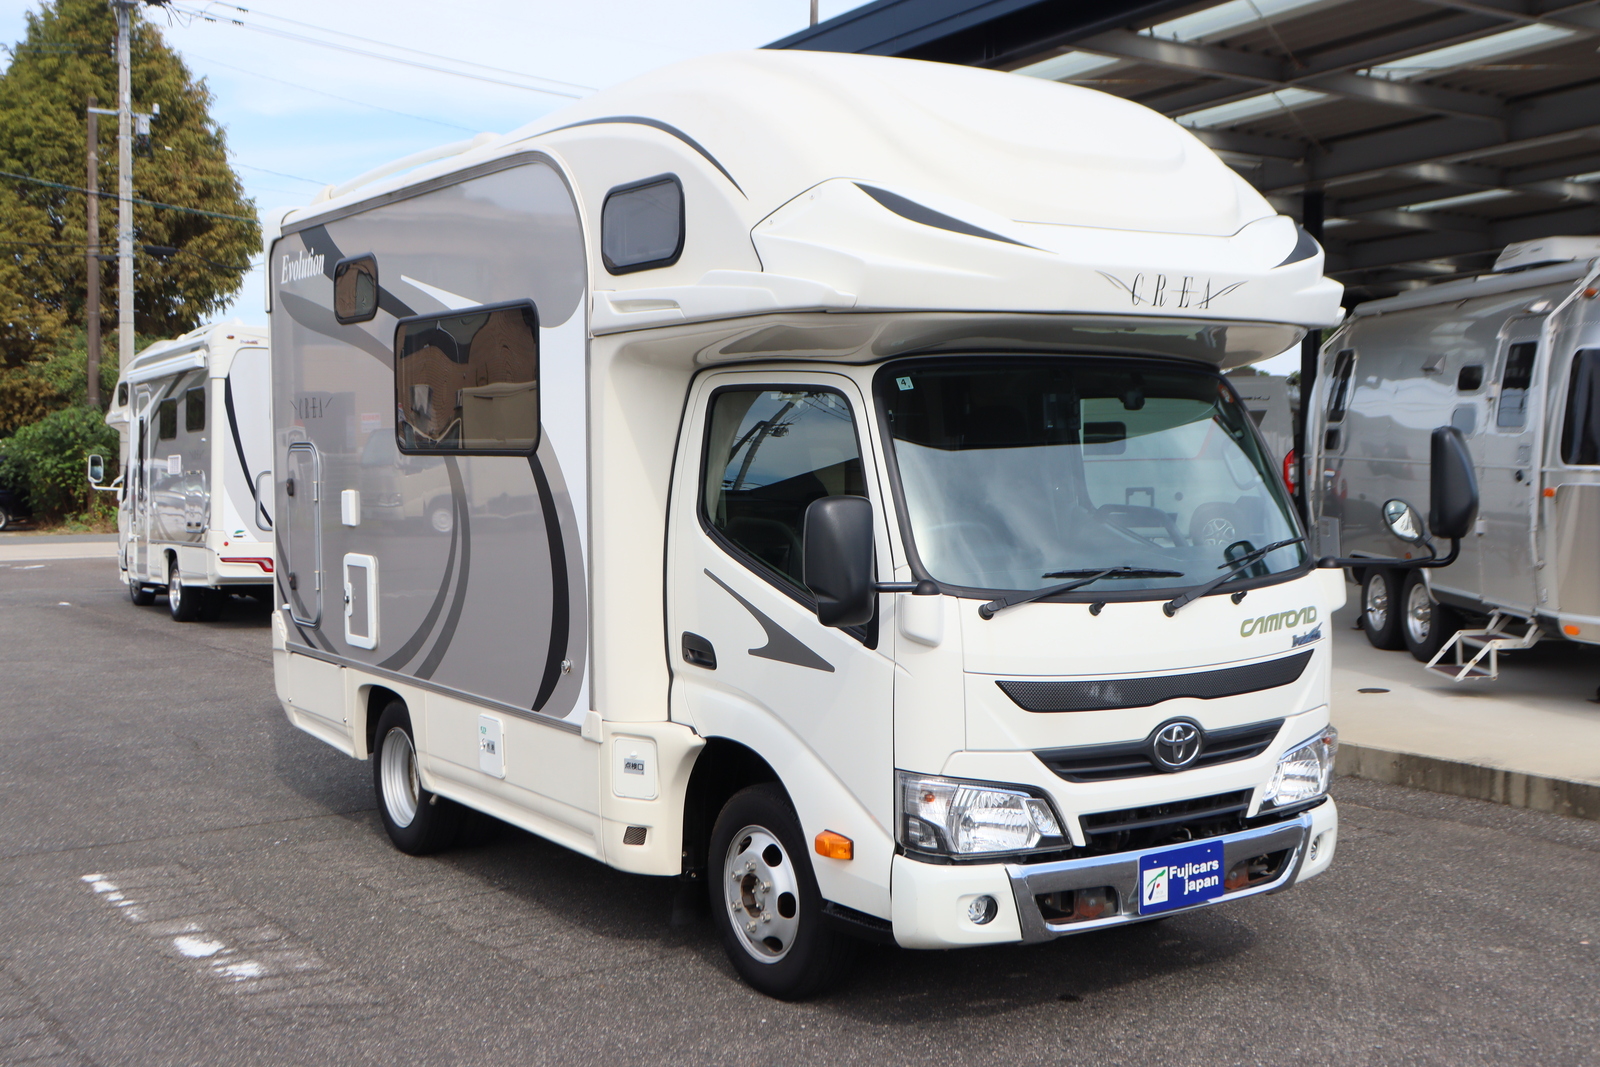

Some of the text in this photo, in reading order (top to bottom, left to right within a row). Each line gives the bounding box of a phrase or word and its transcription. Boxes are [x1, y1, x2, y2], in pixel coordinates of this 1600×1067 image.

[281, 247, 325, 284] Evolution
[1128, 272, 1214, 310] CREA
[1169, 860, 1219, 880] Fujicars
[1184, 875, 1219, 895] japan
